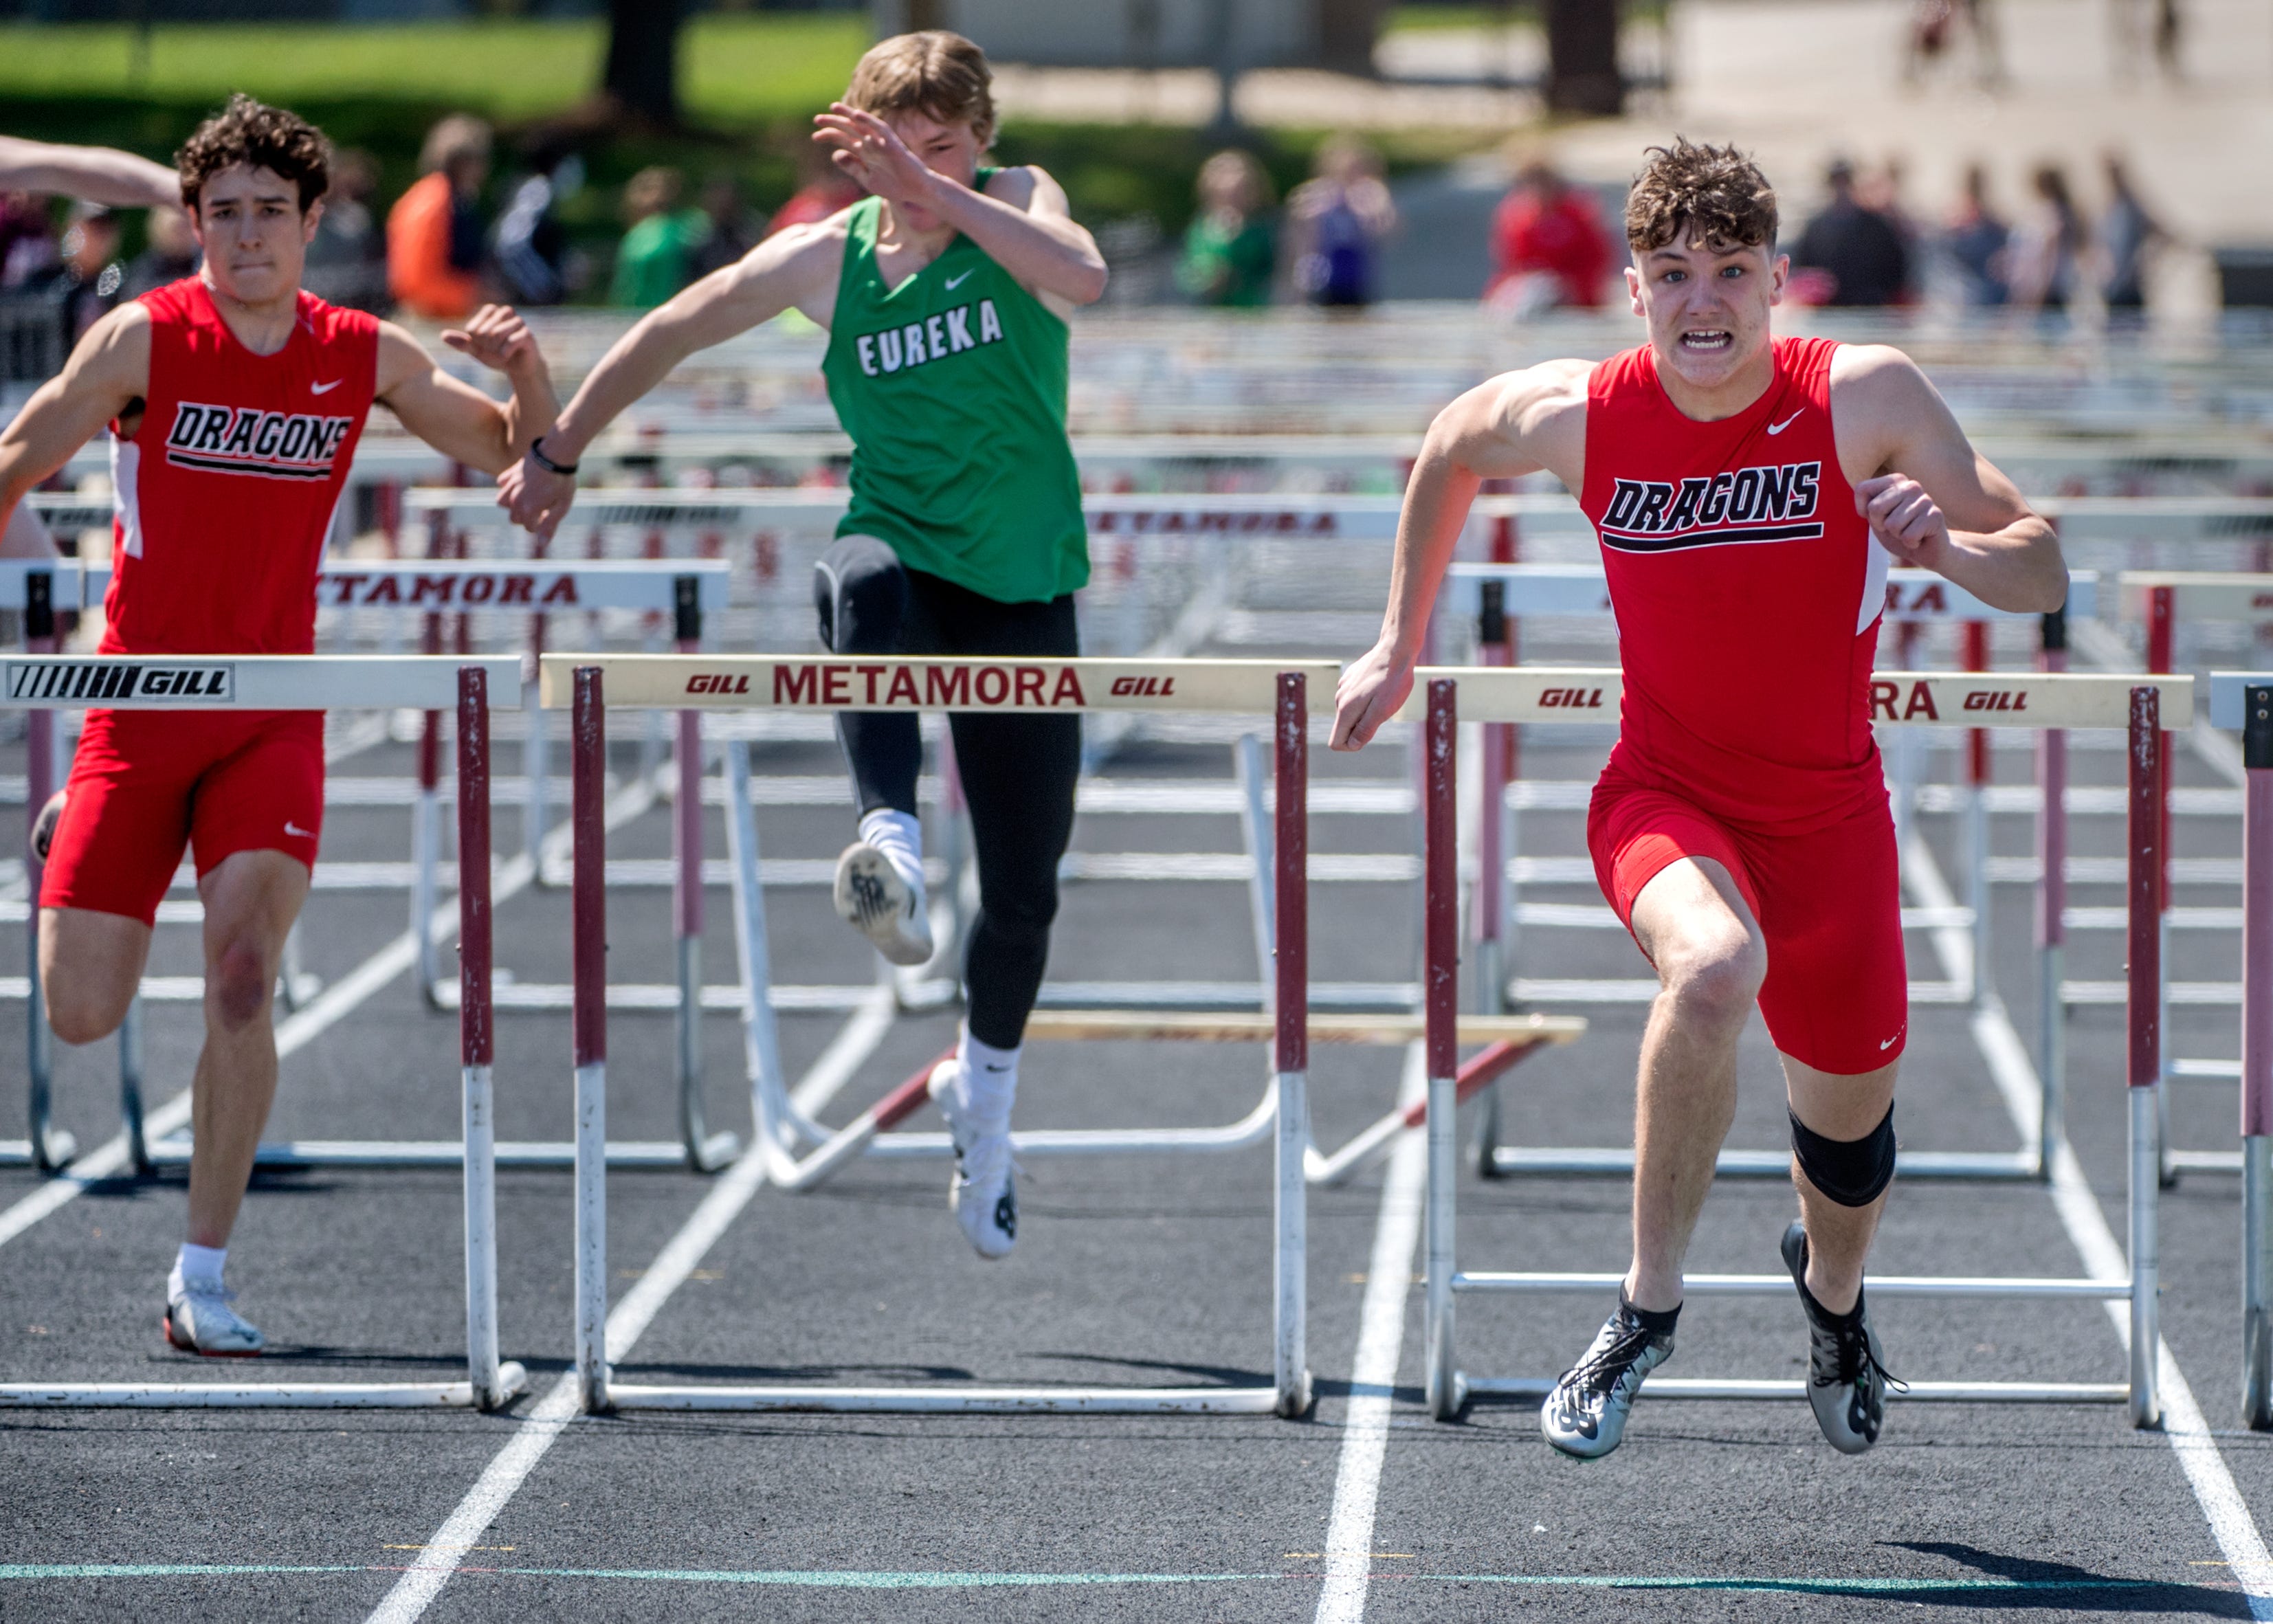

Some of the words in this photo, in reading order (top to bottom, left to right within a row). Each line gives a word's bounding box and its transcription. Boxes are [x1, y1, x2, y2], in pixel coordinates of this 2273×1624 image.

[856, 298, 1004, 377] EUREKA
[165, 401, 354, 463] DRAGONS
[1599, 460, 1821, 533] DRAGONS
[323, 572, 578, 604] TAMORA
[140, 669, 226, 695] GILL
[686, 674, 750, 693] GILL
[773, 665, 1086, 707] METAMORA
[1110, 676, 1175, 696] GILL
[1538, 688, 1603, 707] GILL
[1962, 691, 2027, 711] GILL
